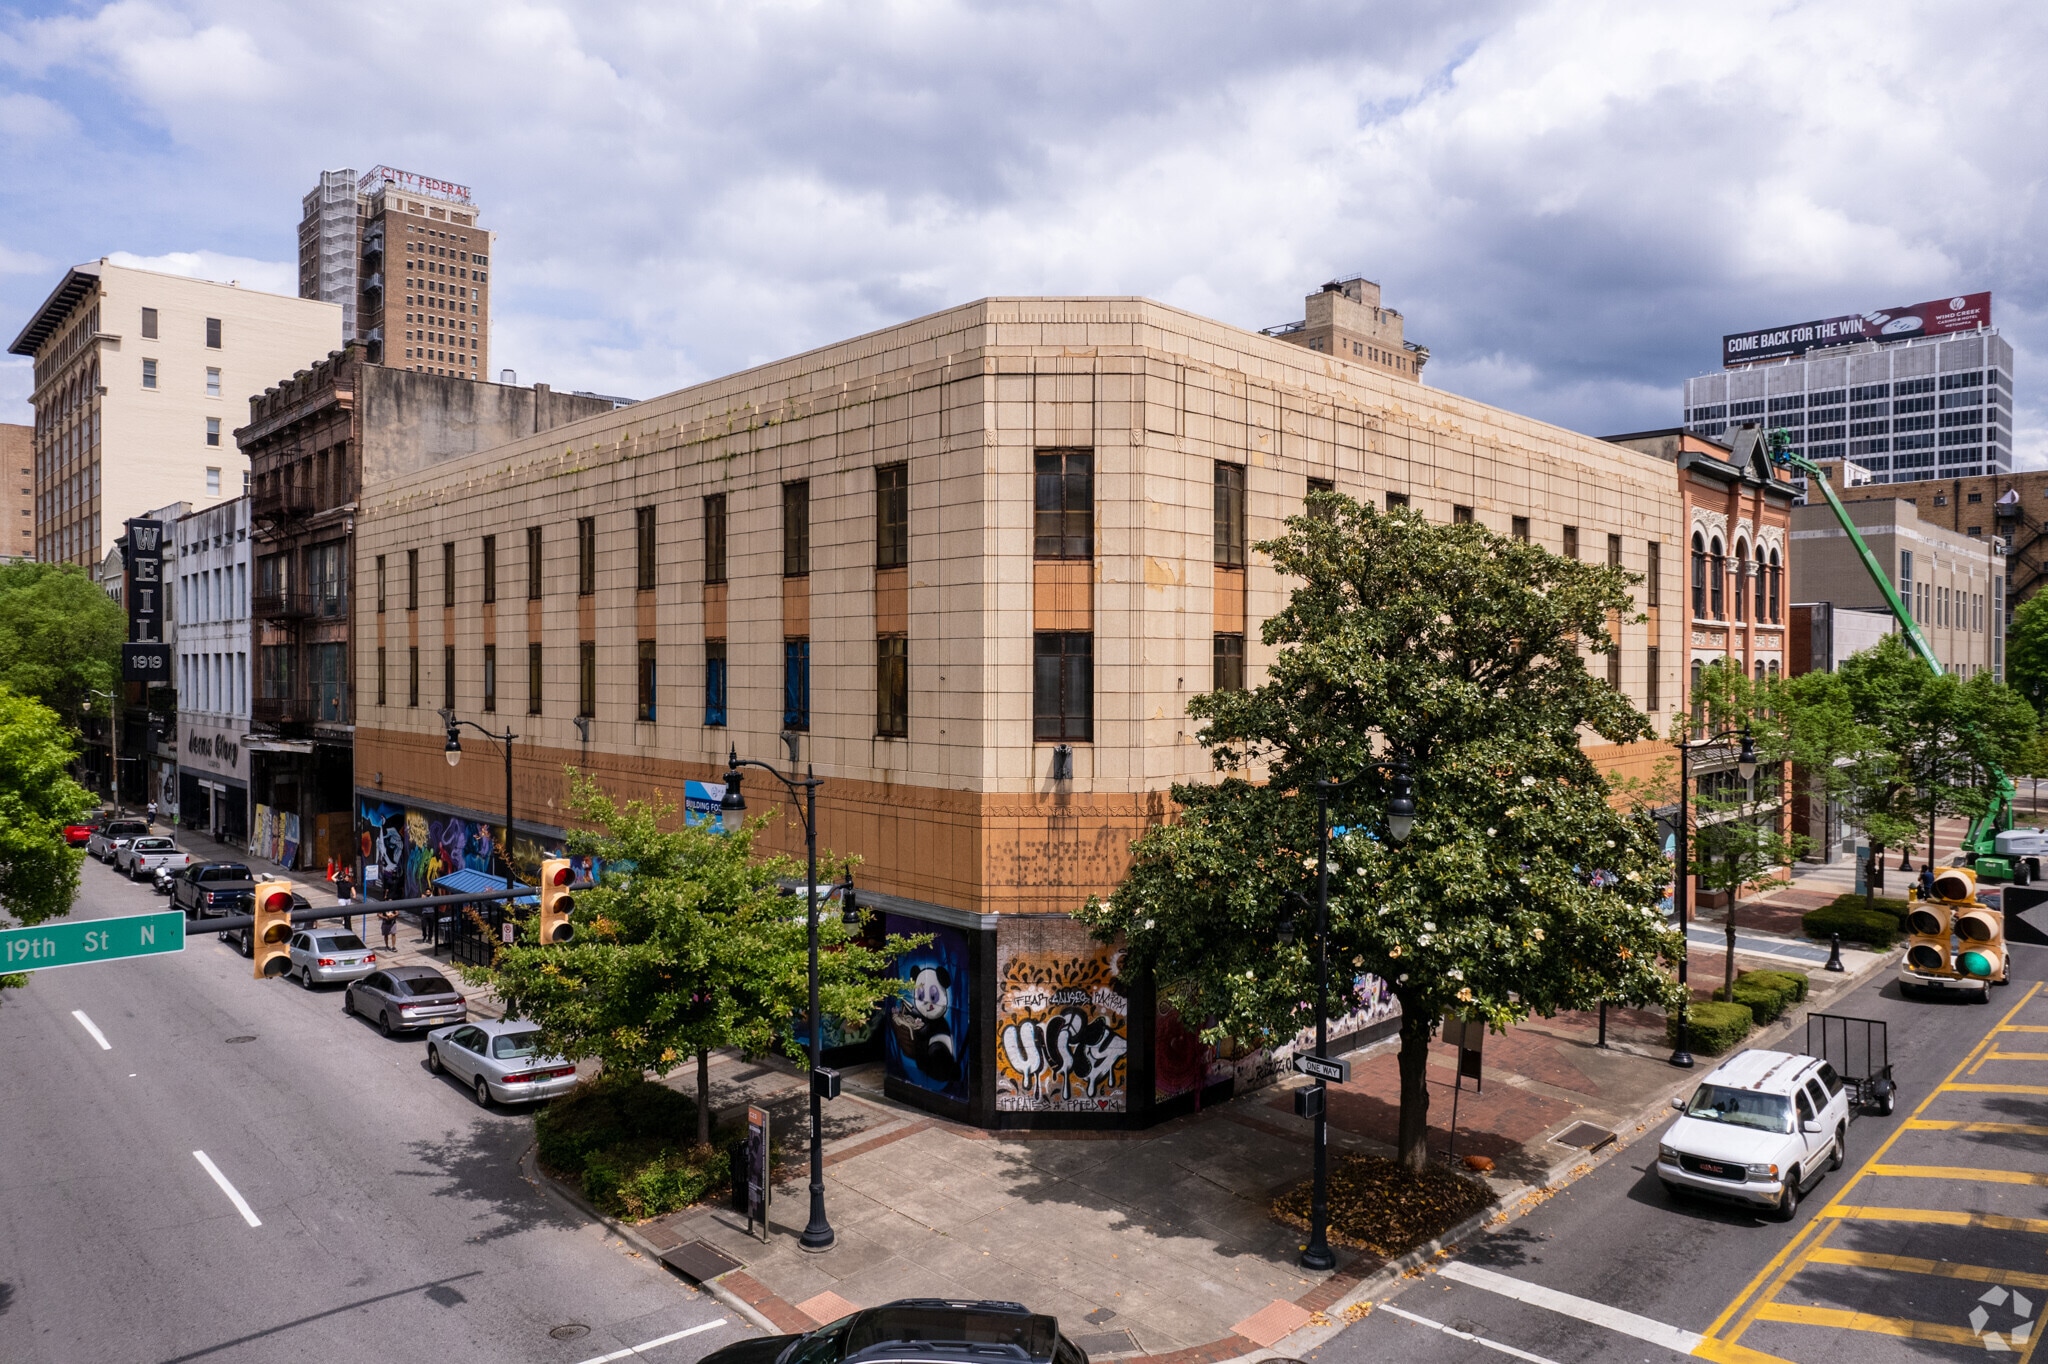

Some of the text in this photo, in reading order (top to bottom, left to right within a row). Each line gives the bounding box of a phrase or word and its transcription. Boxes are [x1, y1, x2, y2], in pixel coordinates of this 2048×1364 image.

[381, 167, 414, 184] CITY
[418, 176, 470, 198] FEDERAL
[1956, 308, 1981, 317] CREEK
[1728, 318, 1866, 353] COME BACK FOR THE WIN.
[133, 526, 160, 643] WEIL
[132, 655, 163, 669] 1919
[686, 799, 710, 811] BUILDING
[6, 924, 155, 962] 19th St N
[1014, 992, 1048, 1007] FEAR
[1306, 1061, 1338, 1077] ONE WAY
